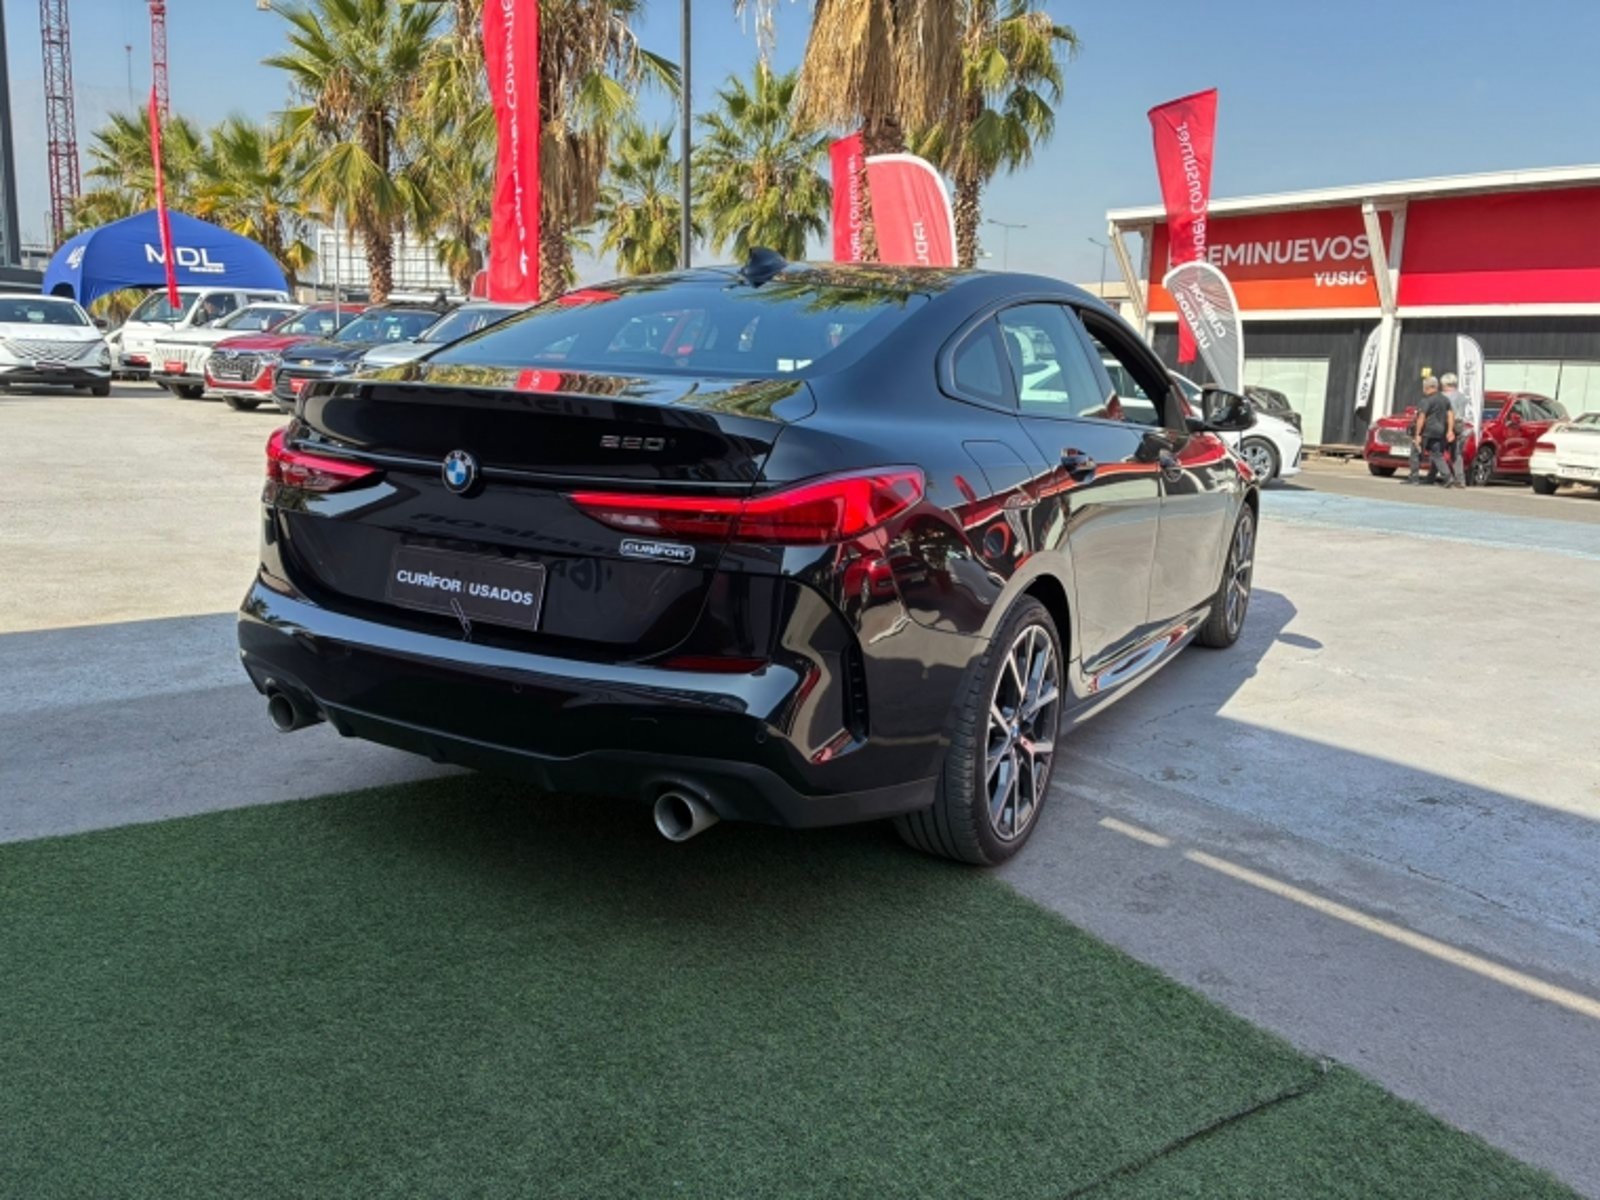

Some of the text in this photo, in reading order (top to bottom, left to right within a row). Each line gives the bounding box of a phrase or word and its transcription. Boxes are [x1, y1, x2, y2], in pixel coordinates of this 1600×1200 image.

[144, 243, 225, 268] MDL
[1203, 234, 1372, 267] EMINUEVOS
[468, 582, 534, 606] USADOS
